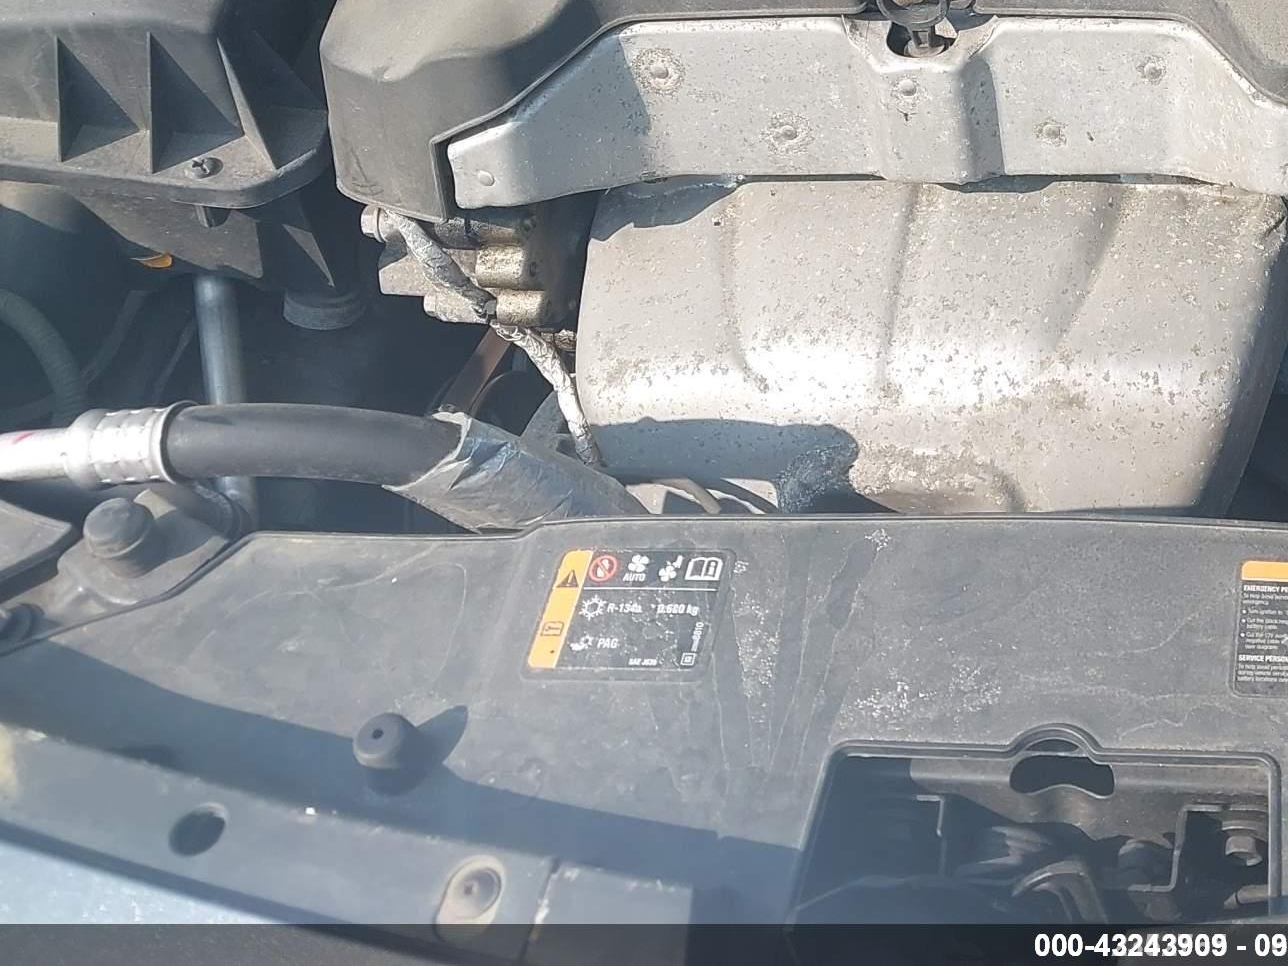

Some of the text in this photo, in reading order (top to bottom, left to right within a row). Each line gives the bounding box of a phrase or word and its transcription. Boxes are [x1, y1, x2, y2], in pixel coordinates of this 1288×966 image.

[622, 572, 646, 582] AUTO
[1243, 585, 1280, 593] EMERGENCY
[686, 603, 699, 616] kg
[597, 637, 618, 649] PAG
[1238, 654, 1265, 662] SERVICE
